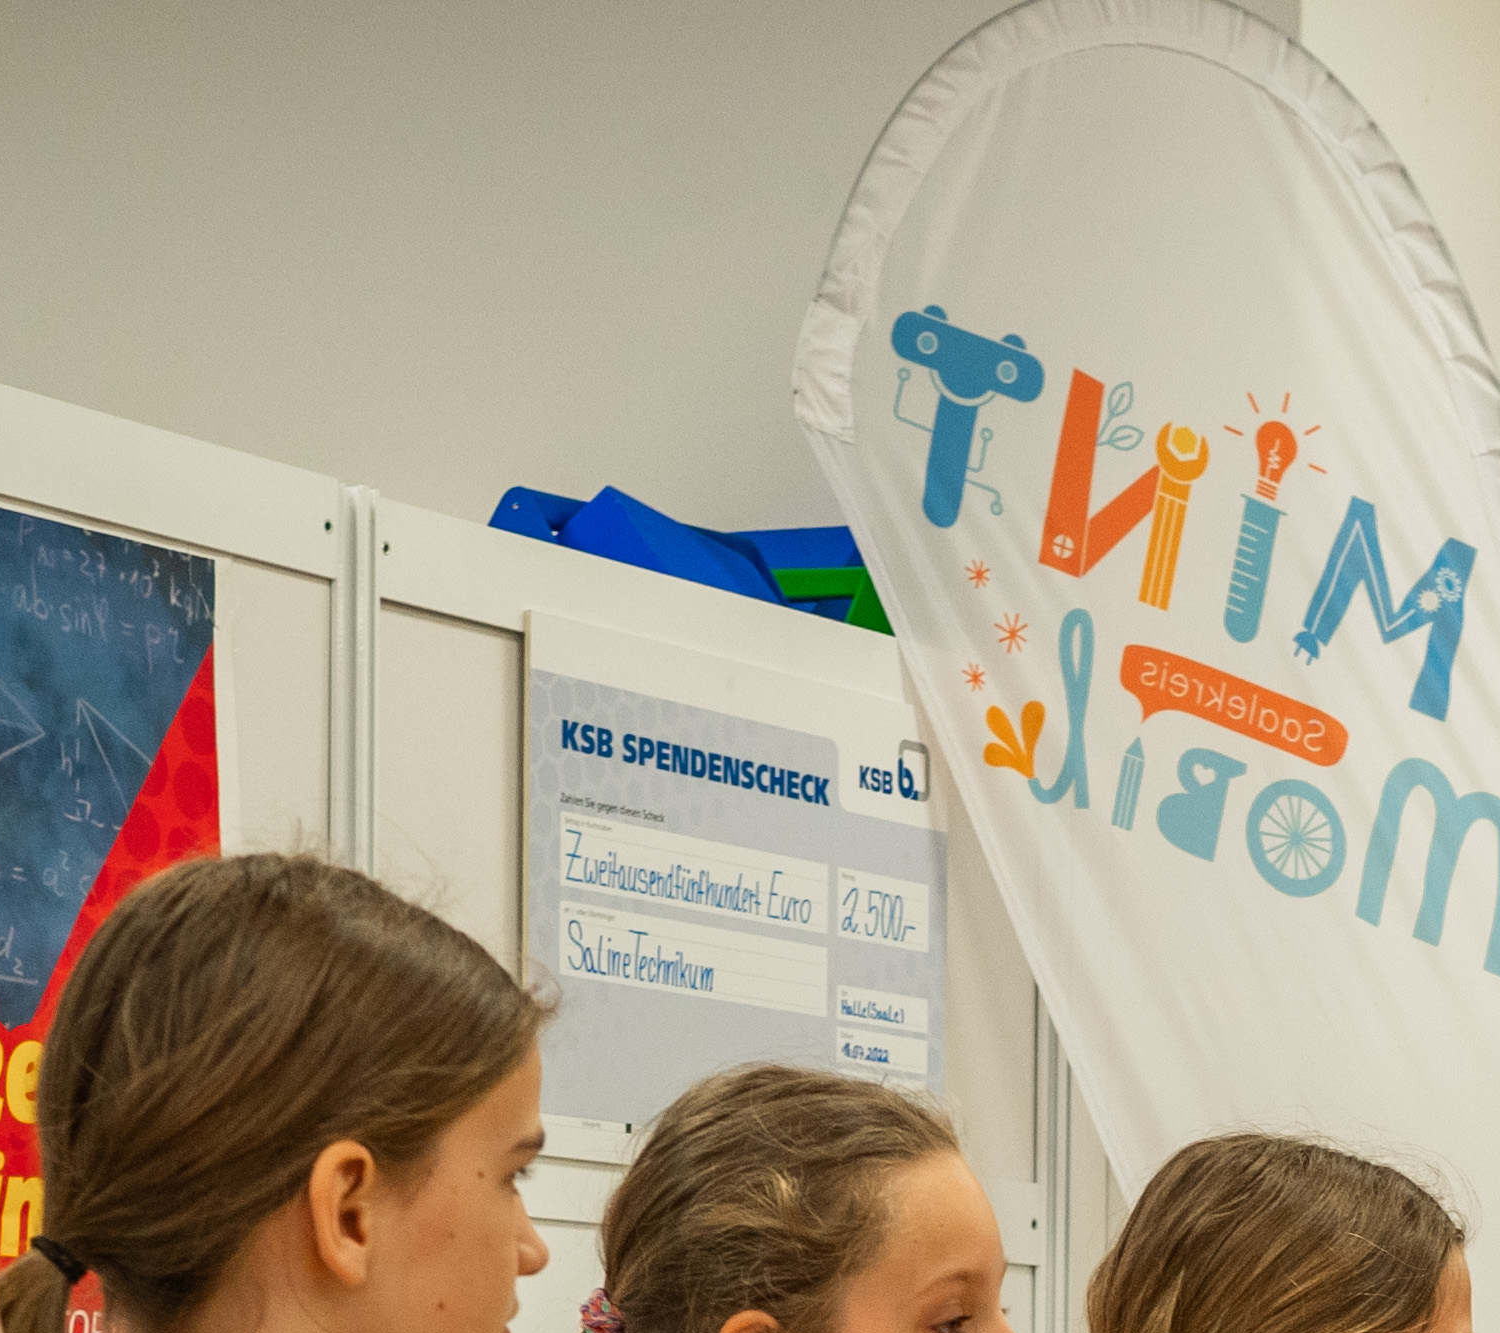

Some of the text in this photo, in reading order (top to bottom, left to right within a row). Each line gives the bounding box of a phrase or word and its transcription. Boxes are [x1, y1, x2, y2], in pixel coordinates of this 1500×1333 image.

[561, 719, 830, 807] KSB SPENDENSCHECK
[859, 764, 893, 795] KSB
[565, 829, 812, 924] Zweitausendfünfhundert Euro
